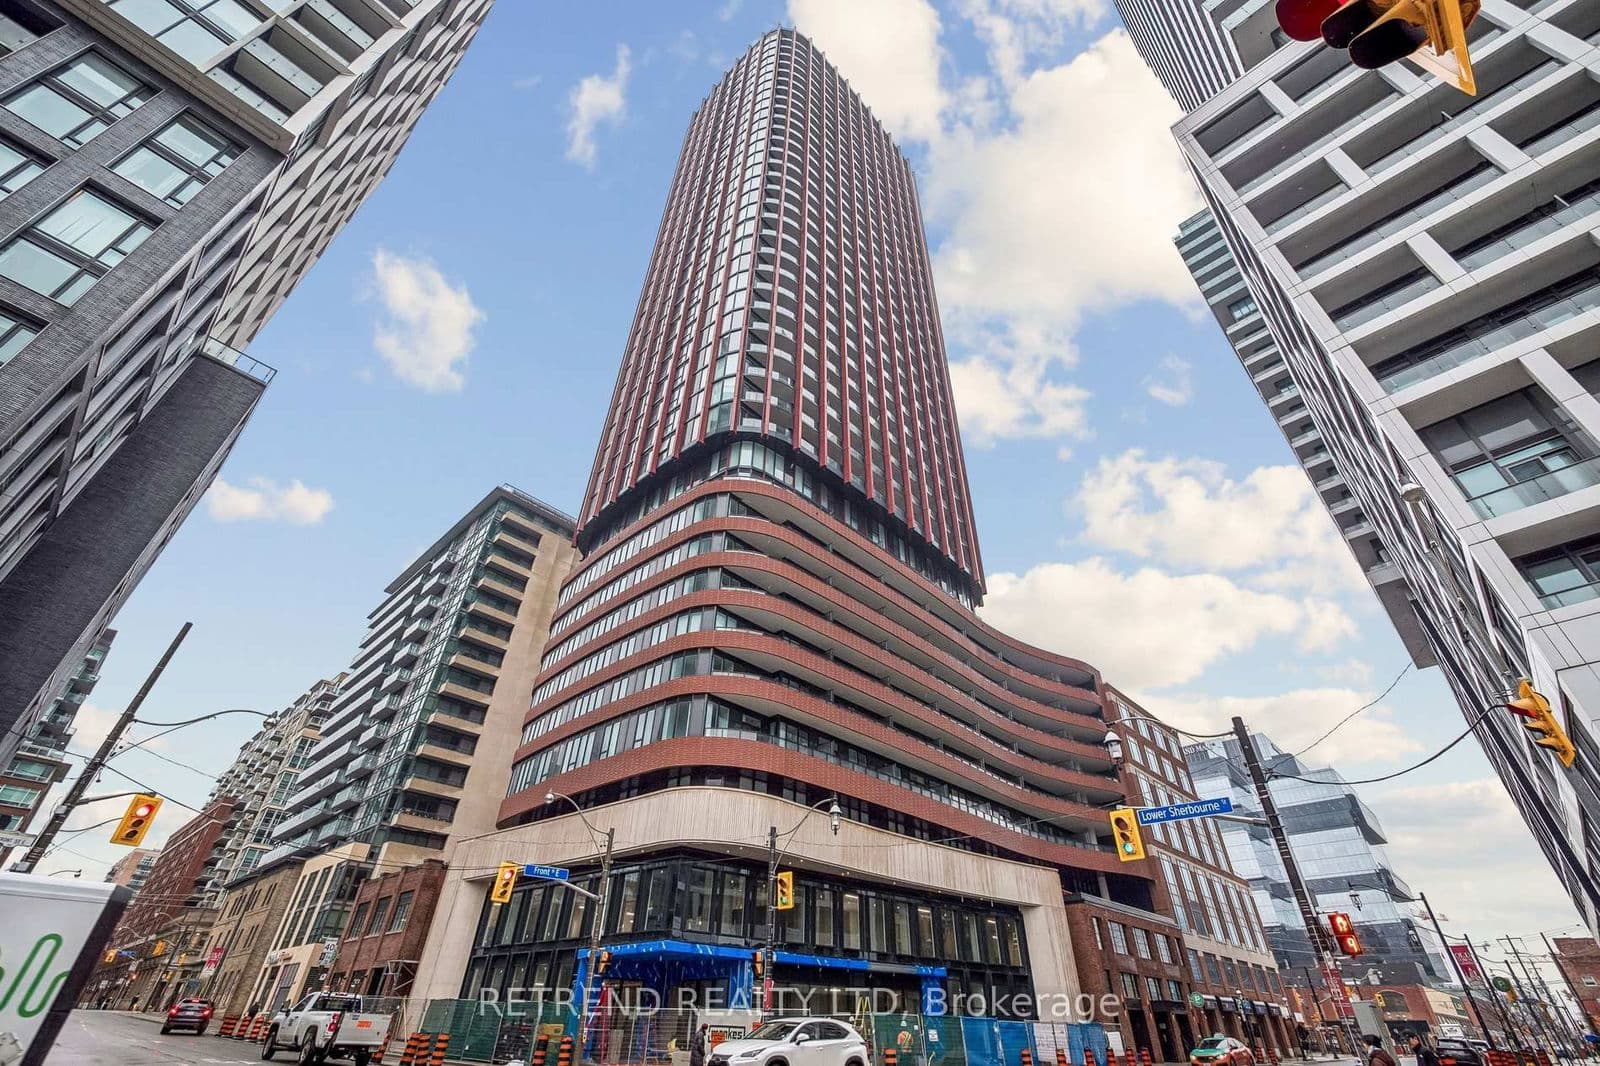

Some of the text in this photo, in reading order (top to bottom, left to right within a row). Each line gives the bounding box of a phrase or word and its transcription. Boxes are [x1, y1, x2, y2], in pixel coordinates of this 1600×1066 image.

[1141, 810, 1166, 821] Lower
[1168, 802, 1220, 817] Sherbourne
[534, 866, 550, 876] Front
[555, 869, 561, 877] E
[325, 943, 335, 951] 40
